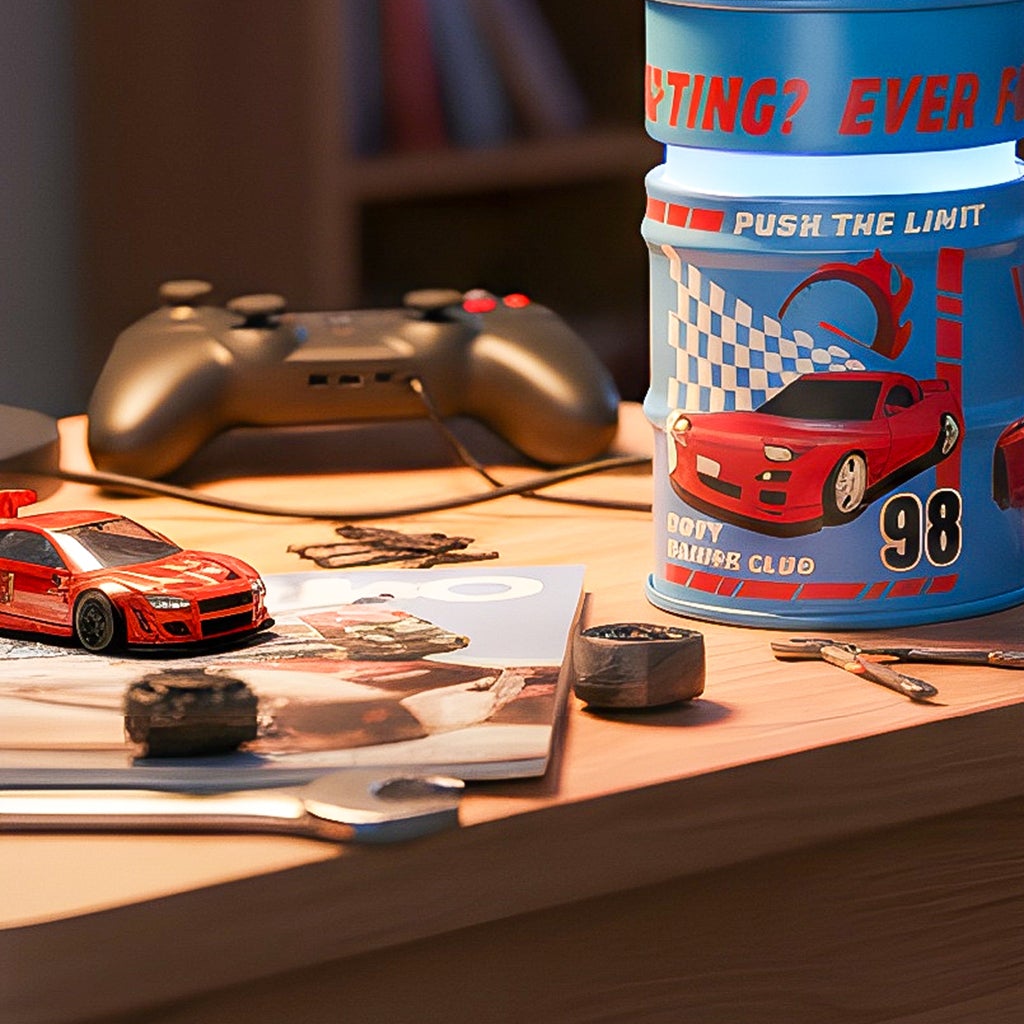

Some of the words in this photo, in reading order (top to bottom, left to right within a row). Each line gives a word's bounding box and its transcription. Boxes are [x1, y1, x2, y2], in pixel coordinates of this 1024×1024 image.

[838, 73, 979, 136] EVER
[733, 211, 822, 237] PUSH
[832, 212, 896, 236] THE
[880, 488, 963, 572] 98
